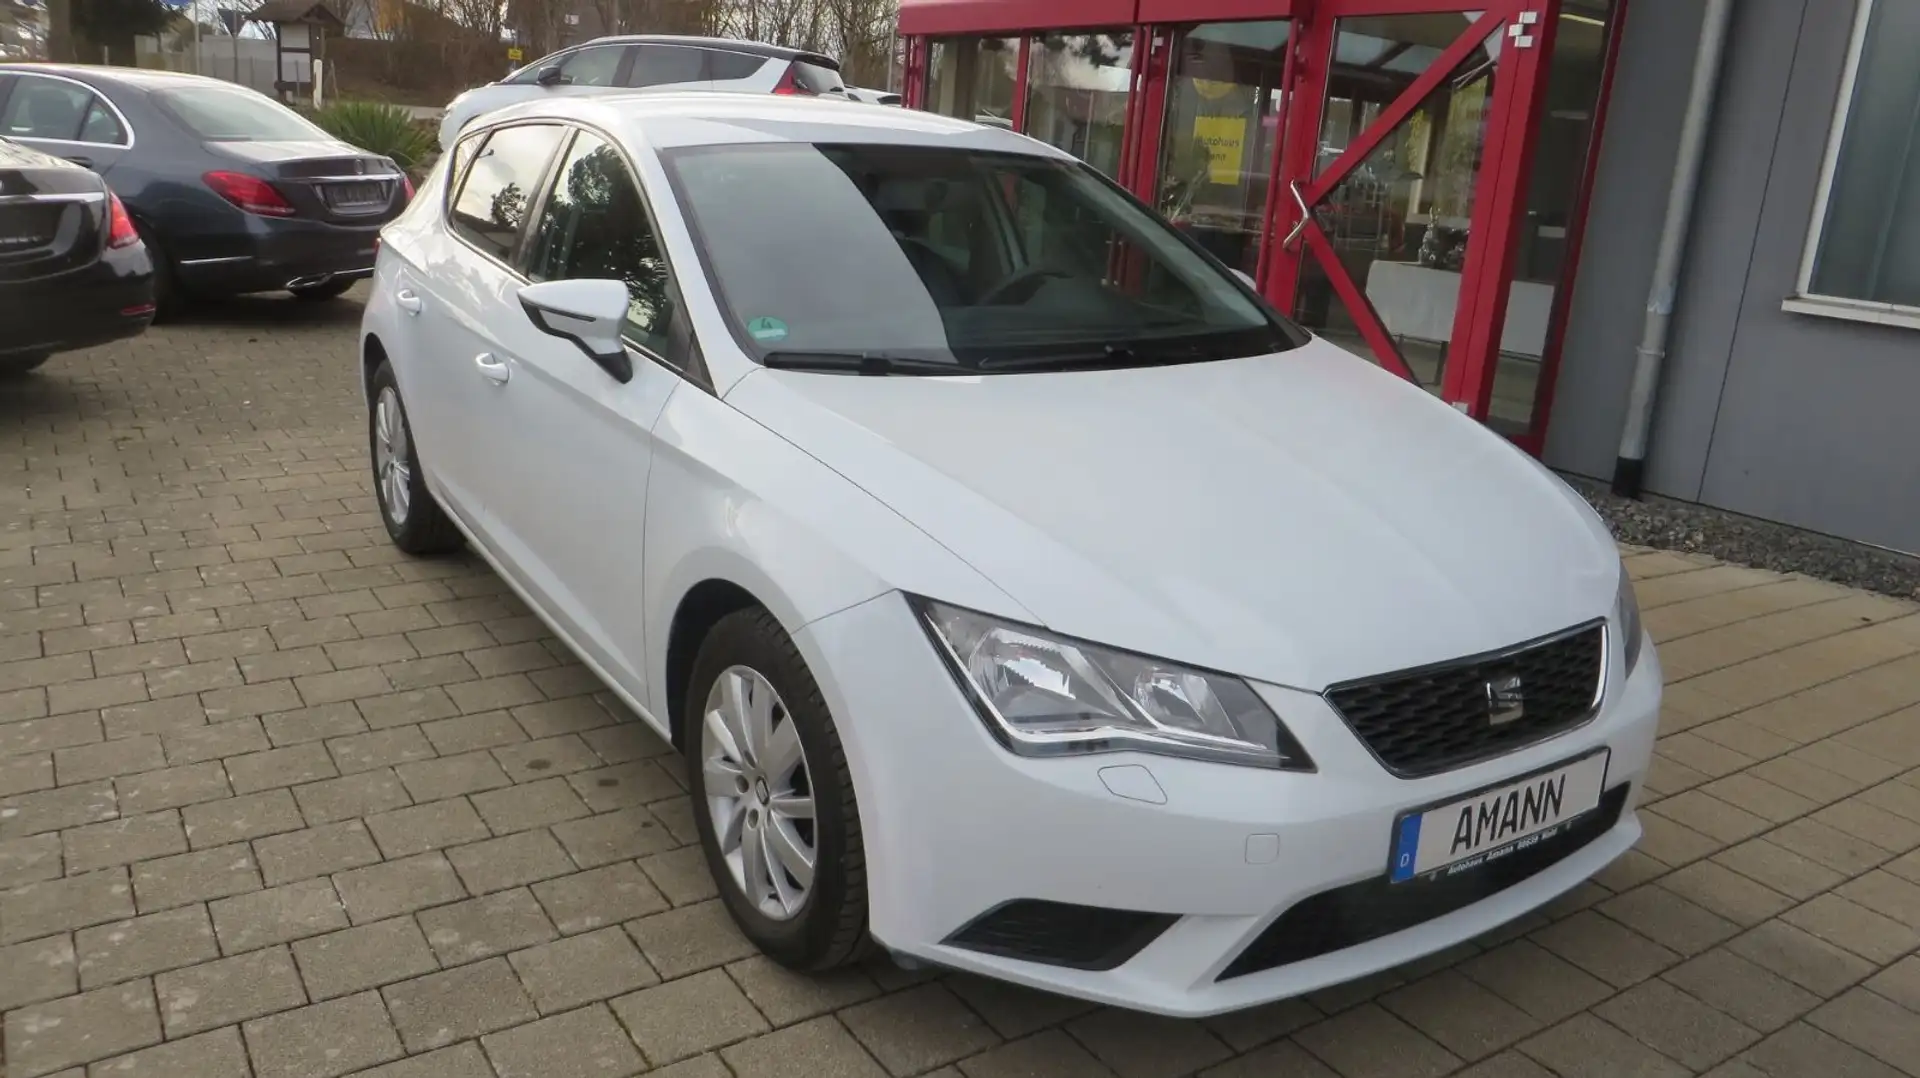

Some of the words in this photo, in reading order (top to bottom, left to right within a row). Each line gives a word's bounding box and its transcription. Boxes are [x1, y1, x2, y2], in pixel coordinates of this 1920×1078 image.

[1449, 774, 1566, 855] AMANN
[1400, 853, 1410, 867] D
[1447, 856, 1484, 876] Autohaus
[1486, 845, 1514, 861] Amann
